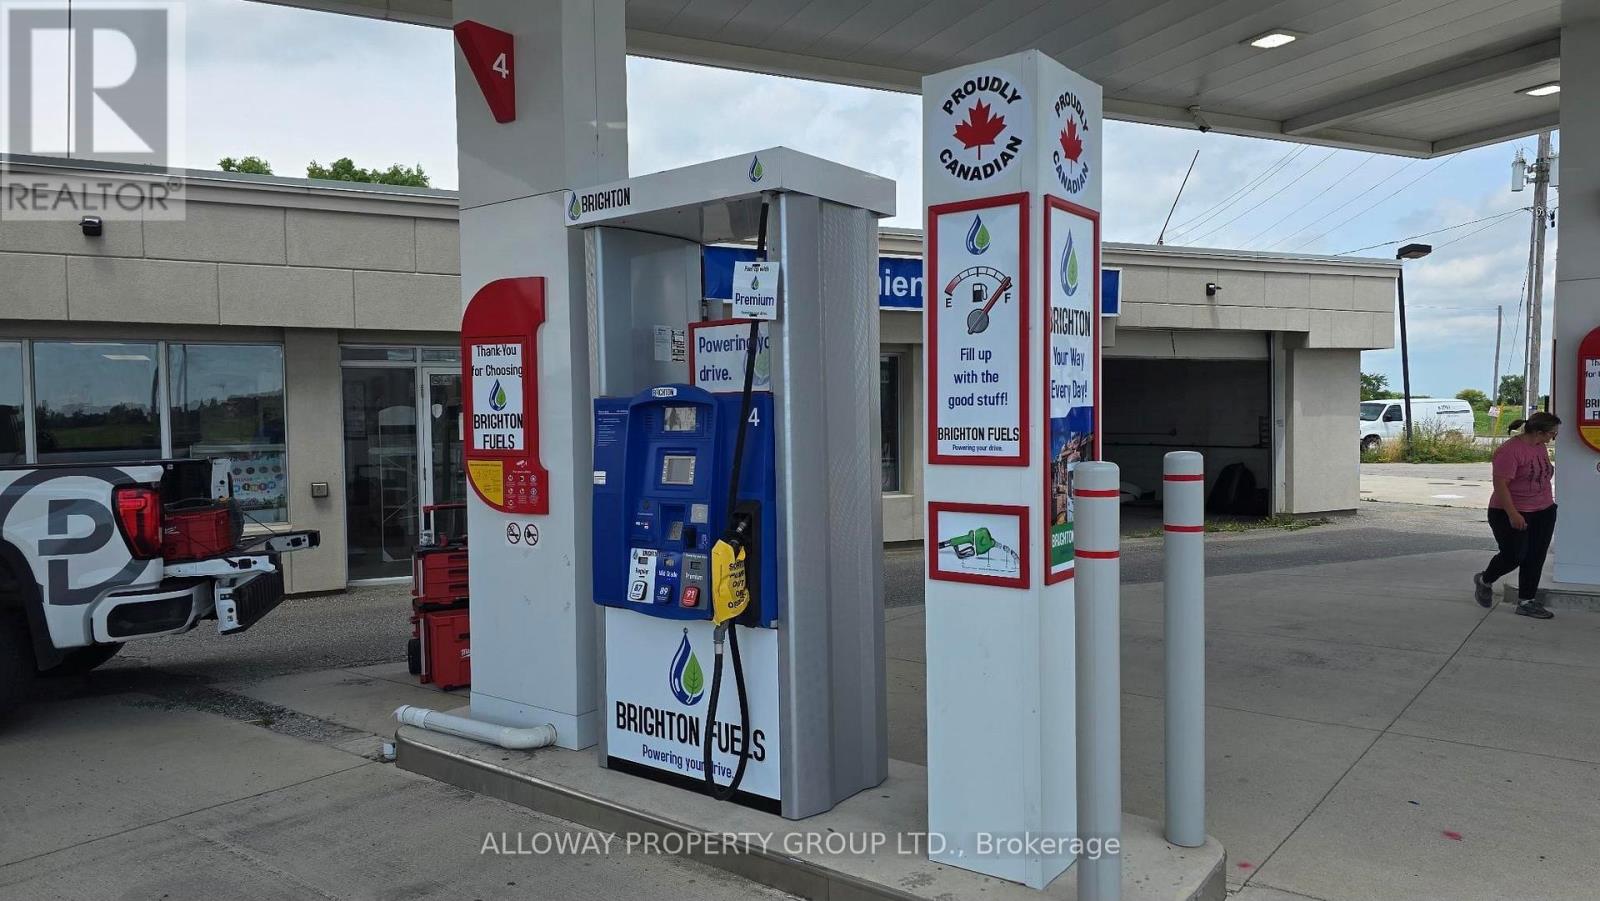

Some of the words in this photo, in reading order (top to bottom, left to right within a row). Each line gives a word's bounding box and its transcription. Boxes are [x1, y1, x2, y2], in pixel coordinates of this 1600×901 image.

[492, 52, 509, 79] 4
[942, 75, 1023, 116] PROUDLY
[1054, 91, 1088, 133] PROUDLY
[939, 135, 1023, 182] CANADIAN
[1053, 150, 1089, 194] CANADIAN
[581, 187, 631, 213] BRIGHTON
[735, 292, 775, 306] Premium
[945, 297, 952, 308] E
[1004, 293, 1011, 304] F
[960, 347, 975, 361] Fill
[978, 349, 992, 363] up
[1053, 346, 1069, 366] Your
[1070, 347, 1085, 371] Way
[472, 365, 483, 376] for
[485, 363, 523, 378] Choosing
[699, 364, 732, 381] drive.
[953, 370, 978, 384] with
[981, 369, 999, 383] the
[1051, 380, 1071, 403] Every
[1072, 380, 1088, 403] Day!
[948, 393, 974, 410] good
[976, 392, 1008, 406] stuff!
[474, 413, 523, 429] BRIGHTON
[747, 407, 760, 427] 4
[482, 433, 515, 449] FUELS
[937, 427, 985, 441] BRIGHTON
[987, 427, 1020, 442] FUELS
[952, 444, 976, 452] Powering
[634, 584, 643, 592] 87
[659, 586, 668, 595] 89
[686, 590, 695, 598] 91
[615, 700, 700, 747] BRIGHTON
[642, 743, 683, 771] Powering
